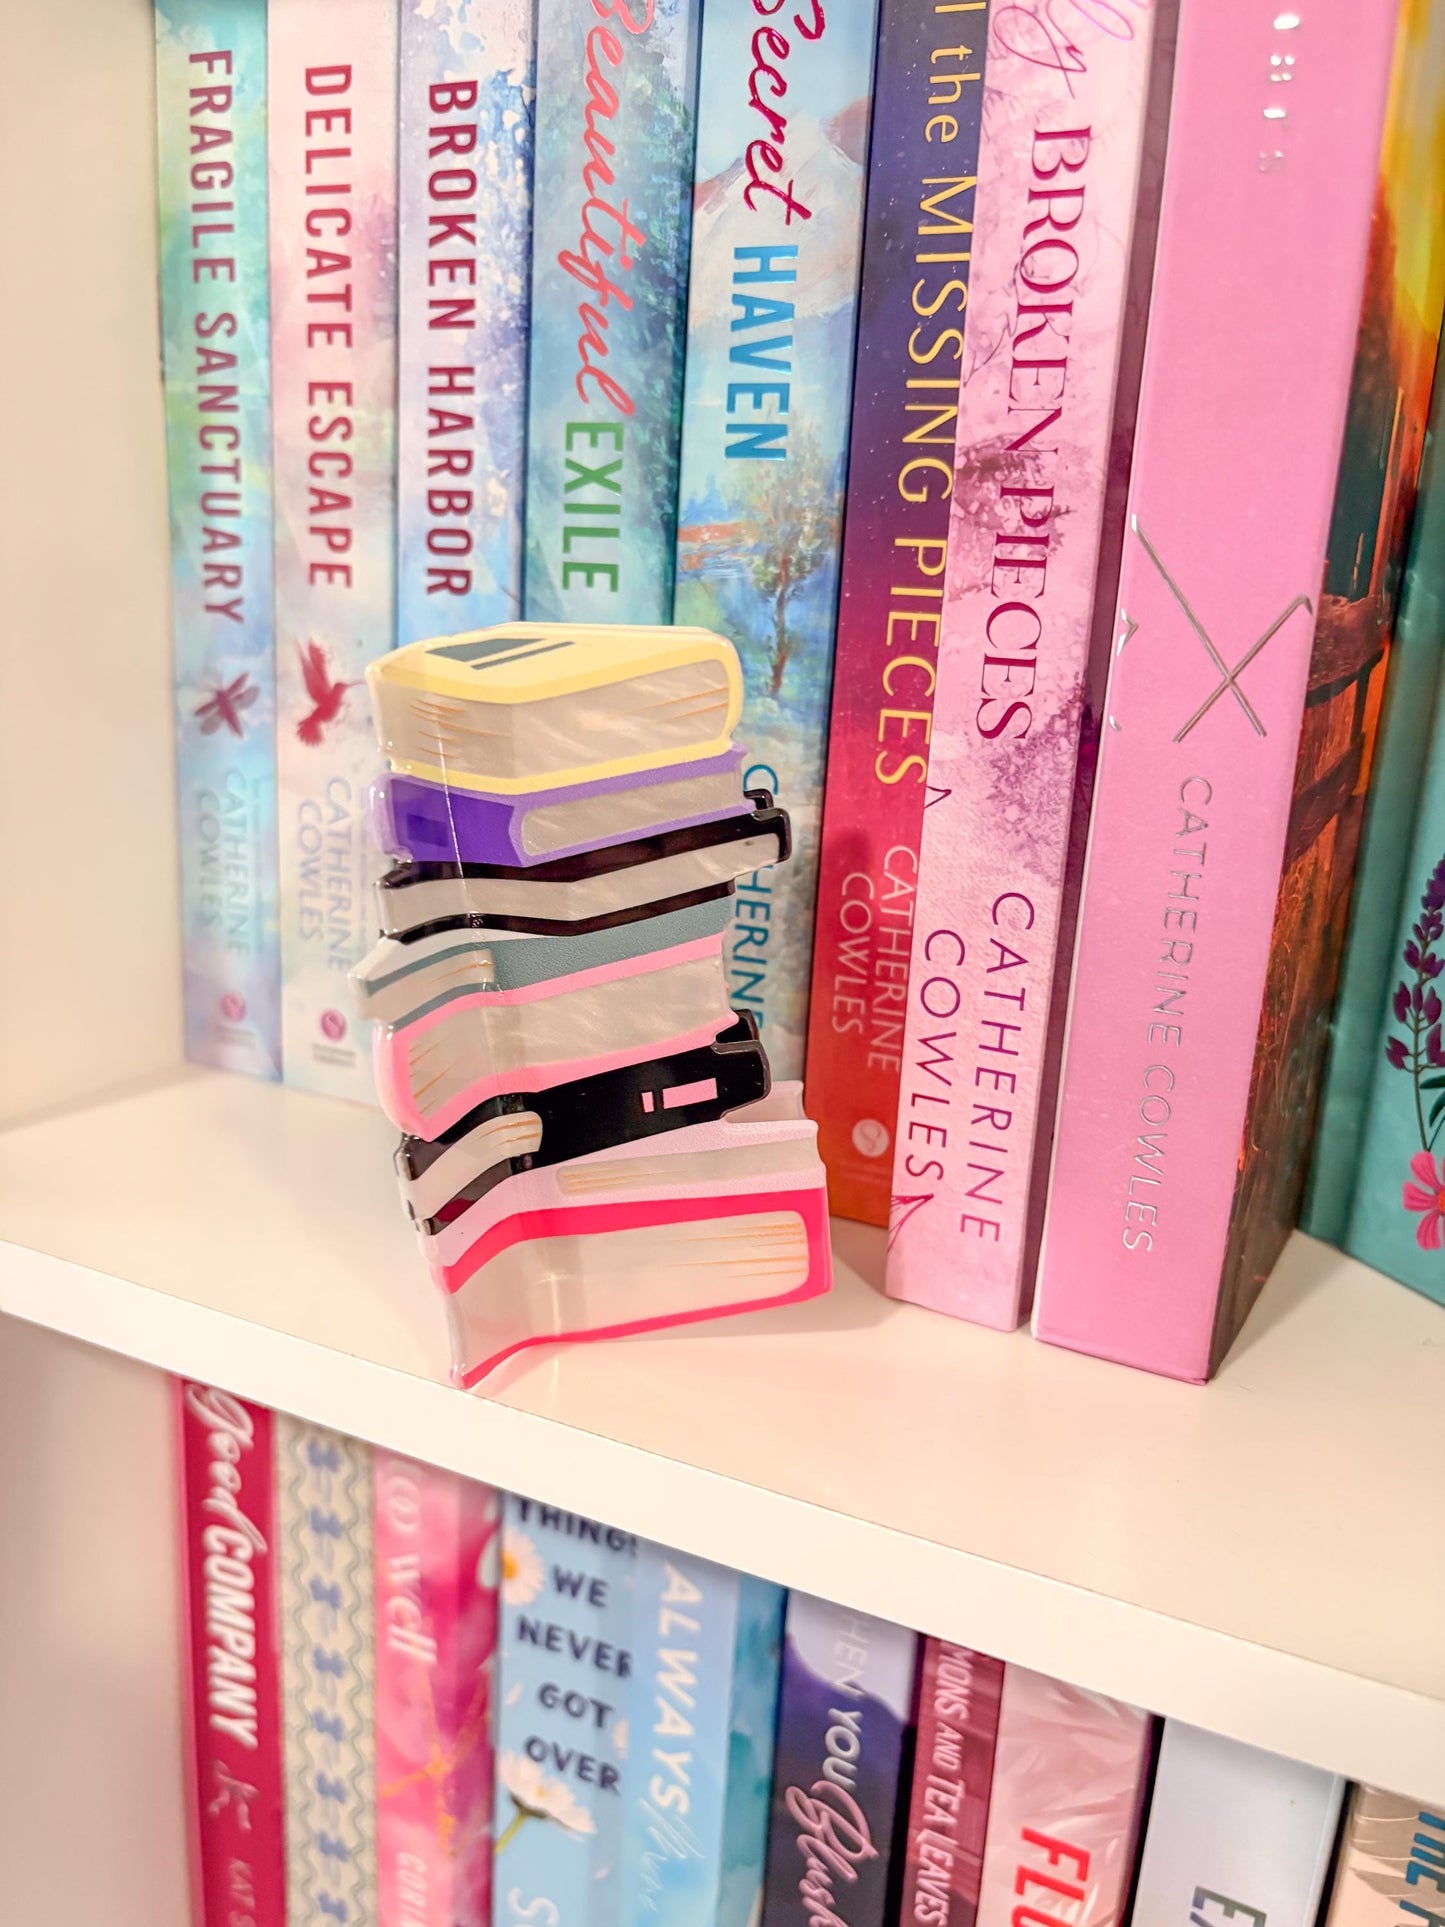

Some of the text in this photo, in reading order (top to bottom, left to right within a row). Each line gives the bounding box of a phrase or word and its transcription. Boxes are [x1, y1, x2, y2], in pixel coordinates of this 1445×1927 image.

[924, 44, 981, 144] the
[188, 50, 245, 624] FRAGILE SANCTUARY
[304, 64, 353, 589] DELICATE ESCAPE
[425, 79, 479, 596] BROKEN HARBOR
[724, 244, 799, 462] HAVEN
[897, 175, 978, 504] MISSING
[1007, 125, 1092, 456] BROKEN
[562, 422, 624, 593] EXILE
[874, 537, 948, 785] PIECES
[976, 485, 1056, 741] PIECES
[298, 799, 324, 944] COWLES
[325, 775, 353, 973] CATHERINE
[832, 872, 875, 1036] COWLES
[867, 845, 919, 1072] CATHERINE
[905, 929, 967, 1182] COWLES
[958, 890, 1036, 1242] CATHERINE
[1121, 774, 1214, 1252] CATHERINE COWLES
[203, 1524, 259, 1750] COMPANY
[384, 1552, 438, 1666] well
[516, 1615, 633, 1679] NEVER
[552, 1564, 610, 1609] WE
[650, 1562, 704, 1815] ALWAYS
[524, 1735, 622, 1794] OVER
[537, 1683, 613, 1729] GOT
[822, 1707, 863, 1789] YOU
[923, 1774, 966, 1828] TEA
[932, 1721, 962, 1771] AND
[912, 1828, 959, 1927] LEAVES
